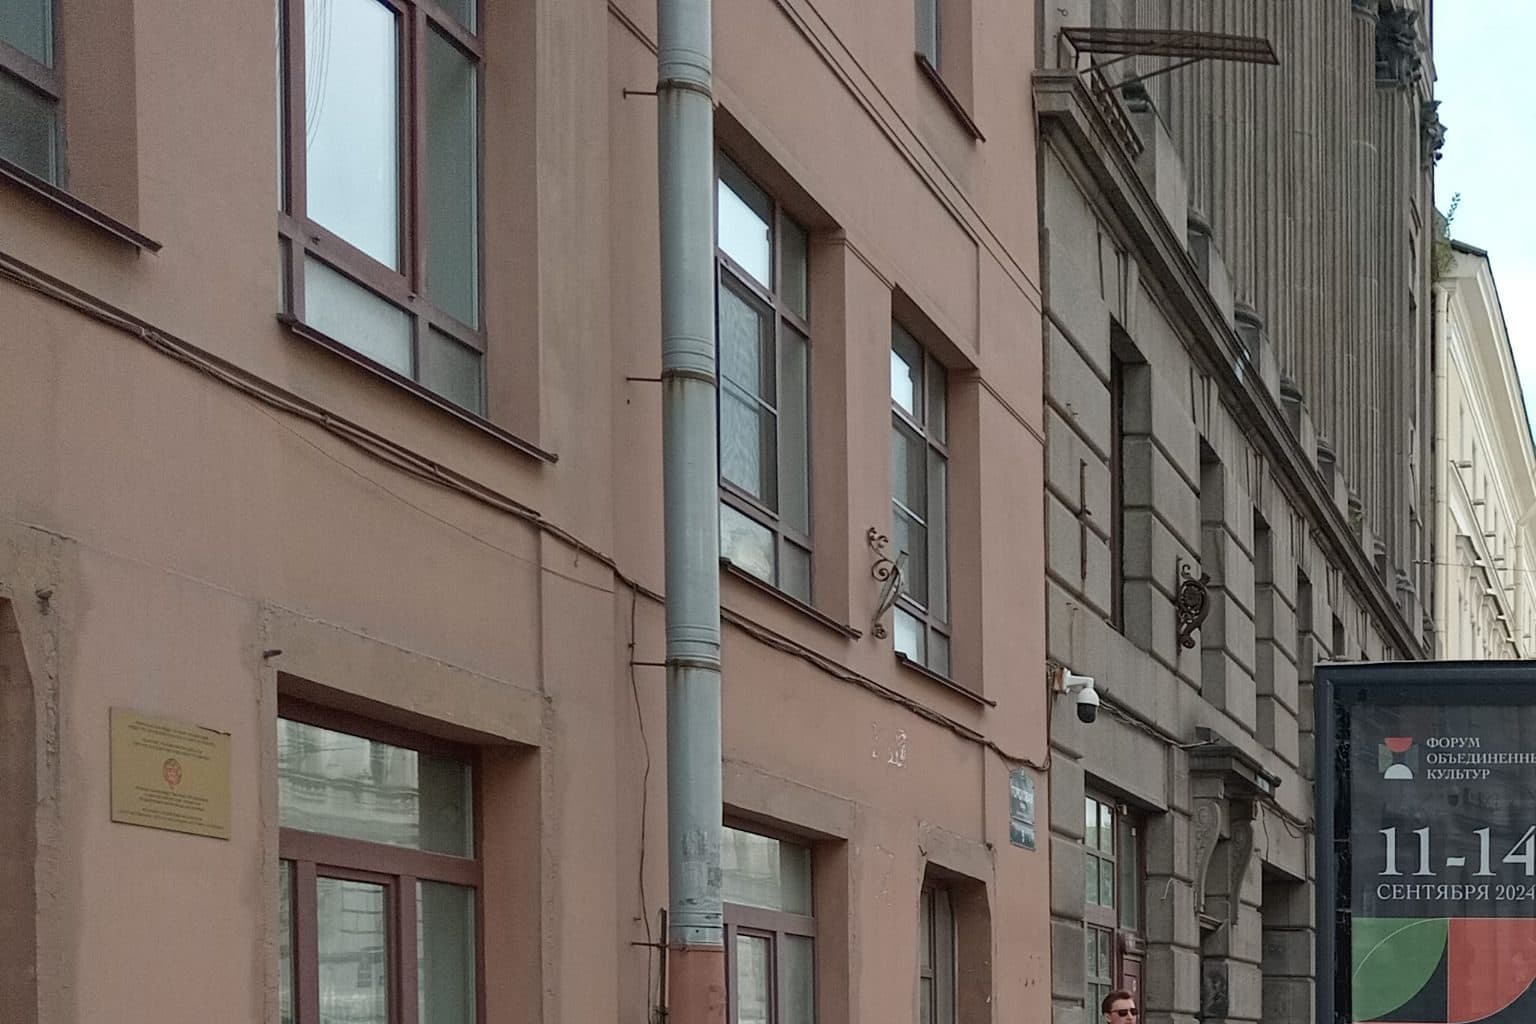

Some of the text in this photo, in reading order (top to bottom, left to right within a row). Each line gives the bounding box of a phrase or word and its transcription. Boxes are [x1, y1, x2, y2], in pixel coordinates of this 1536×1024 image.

[1426, 736, 1480, 749] ФОРУМ
[1426, 767, 1490, 780] КУЛЬТУР
[1378, 825, 1536, 877] 11-14
[1376, 883, 1536, 901] СЕНТЯБРЯ 2024
